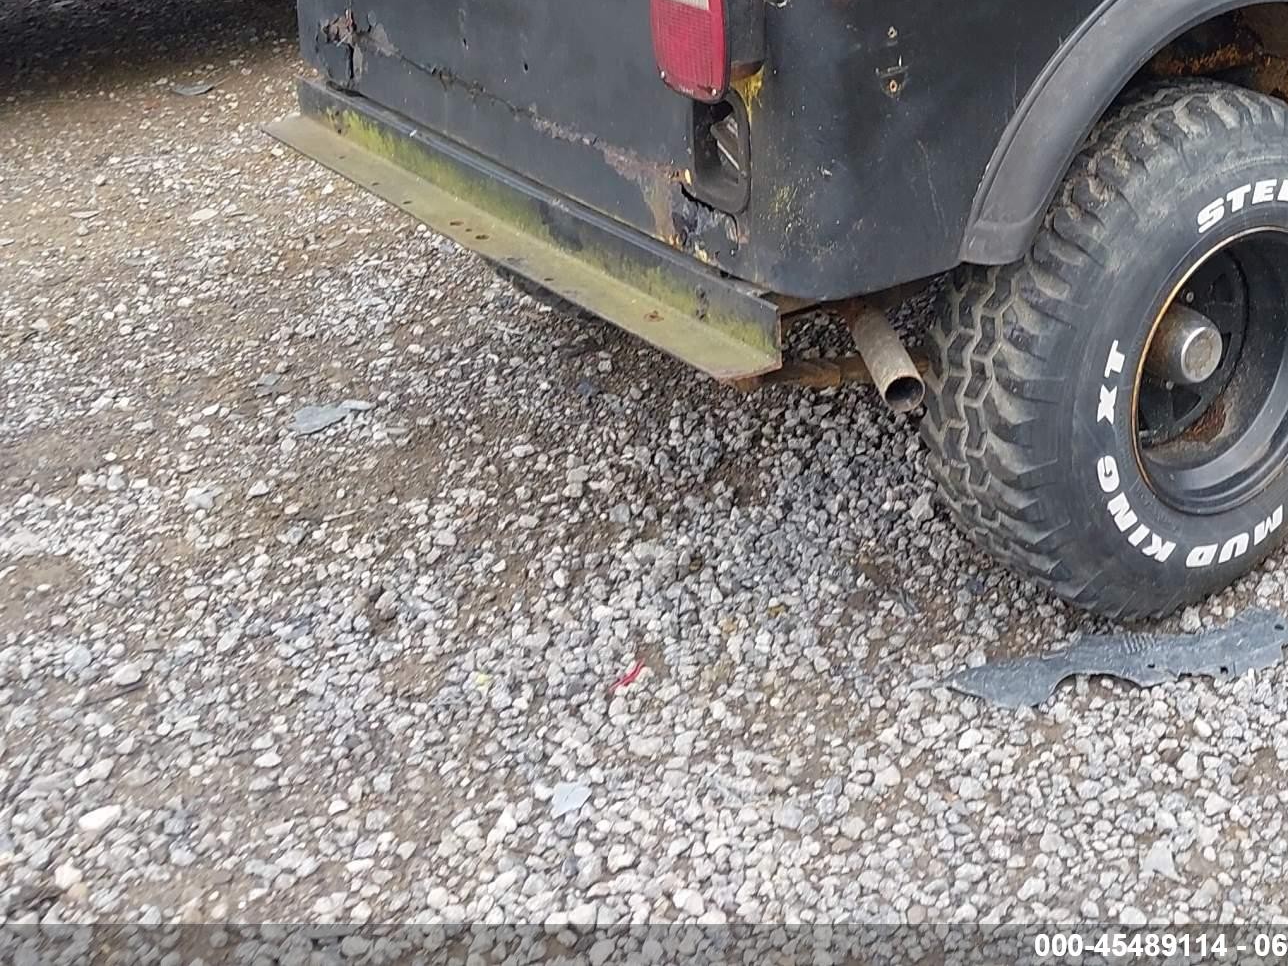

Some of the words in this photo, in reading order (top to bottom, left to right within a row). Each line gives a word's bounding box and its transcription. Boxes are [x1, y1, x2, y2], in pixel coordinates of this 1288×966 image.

[1096, 339, 1126, 425] XT
[1096, 455, 1177, 563] KING
[1185, 505, 1284, 568] MUD
